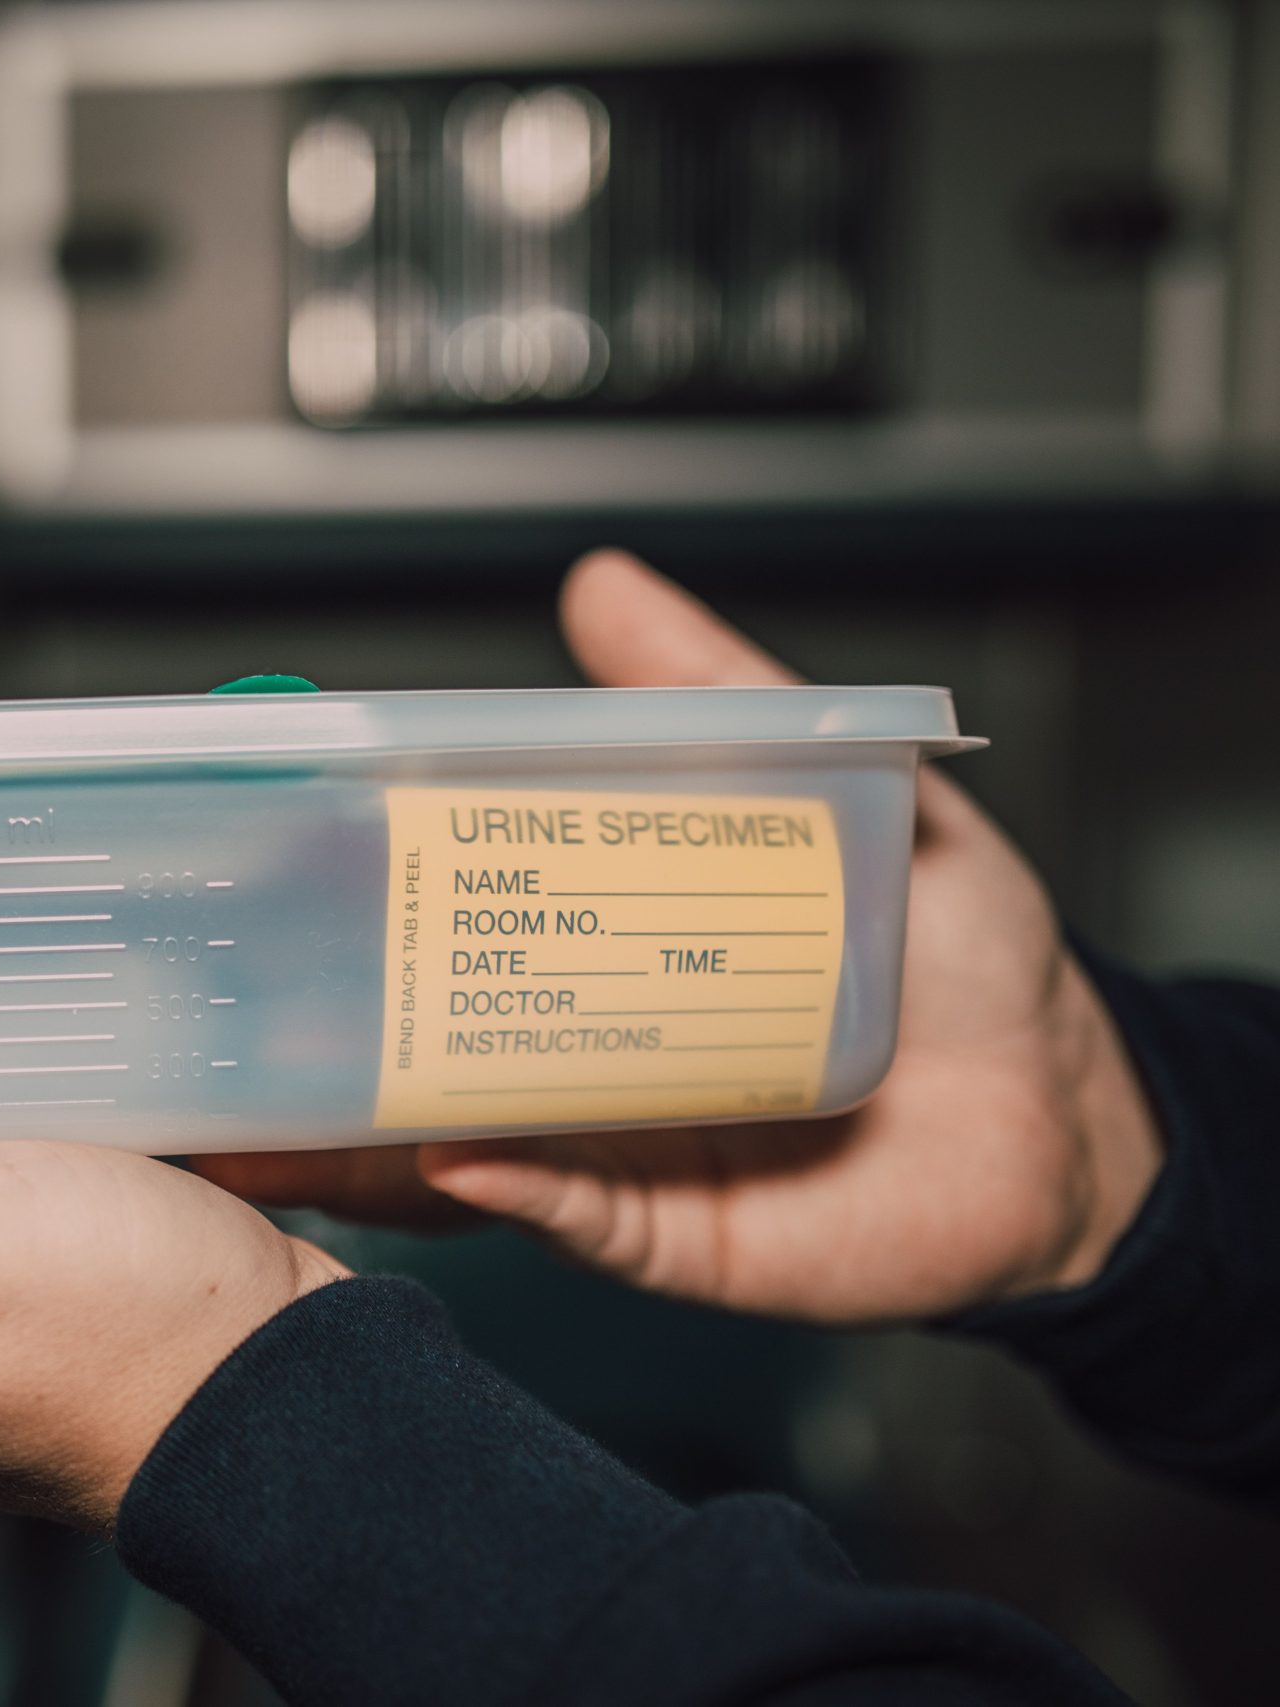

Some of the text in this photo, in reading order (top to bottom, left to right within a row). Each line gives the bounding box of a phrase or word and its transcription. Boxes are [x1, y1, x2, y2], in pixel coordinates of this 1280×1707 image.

[449, 806, 816, 849] URINE SPECIMEN
[452, 869, 541, 896] NAME
[452, 909, 607, 936] ROOM NO.
[141, 935, 202, 964] 700
[397, 846, 422, 1070] BEND BACK TAB & PEEL
[450, 948, 728, 976] DATE TIME
[146, 993, 207, 1021] 500
[448, 989, 576, 1017] DOCTOR
[445, 1026, 663, 1056] INSTRUCTIONS
